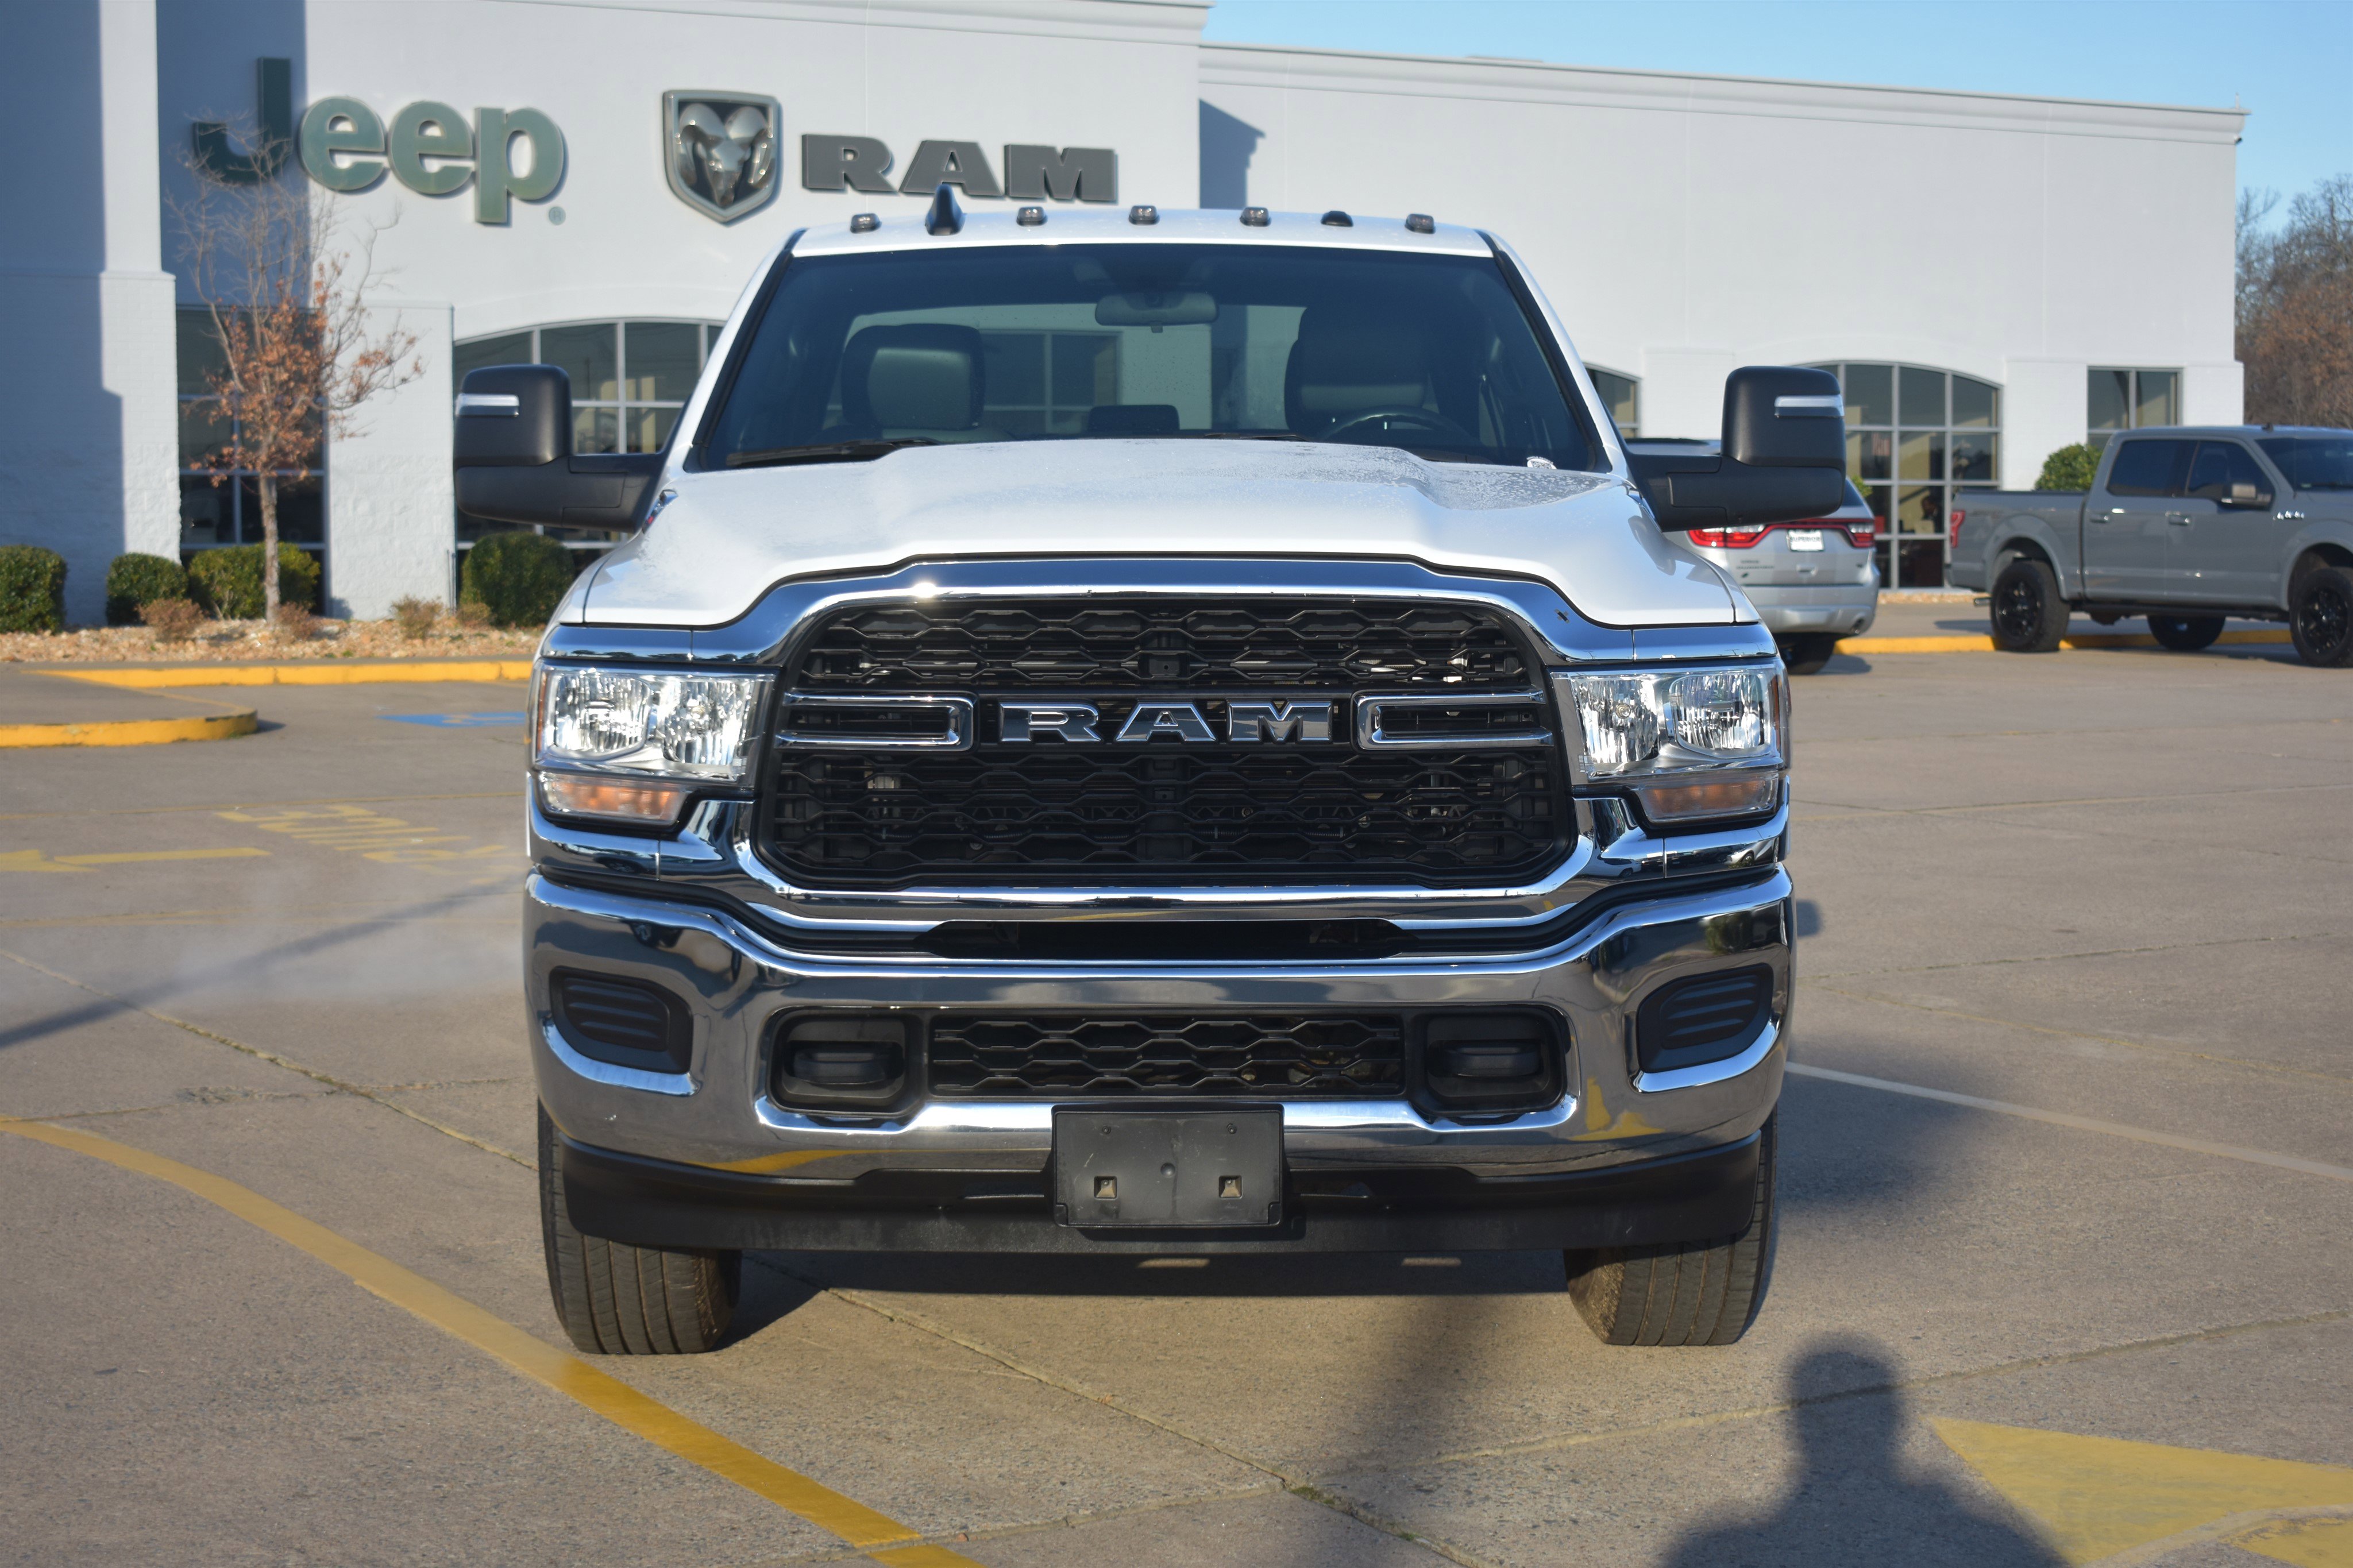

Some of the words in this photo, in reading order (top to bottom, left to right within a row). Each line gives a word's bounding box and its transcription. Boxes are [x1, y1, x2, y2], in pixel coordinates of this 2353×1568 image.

[192, 57, 566, 224] Jeep
[802, 134, 1117, 202] RAM
[998, 701, 1333, 743] RAM
